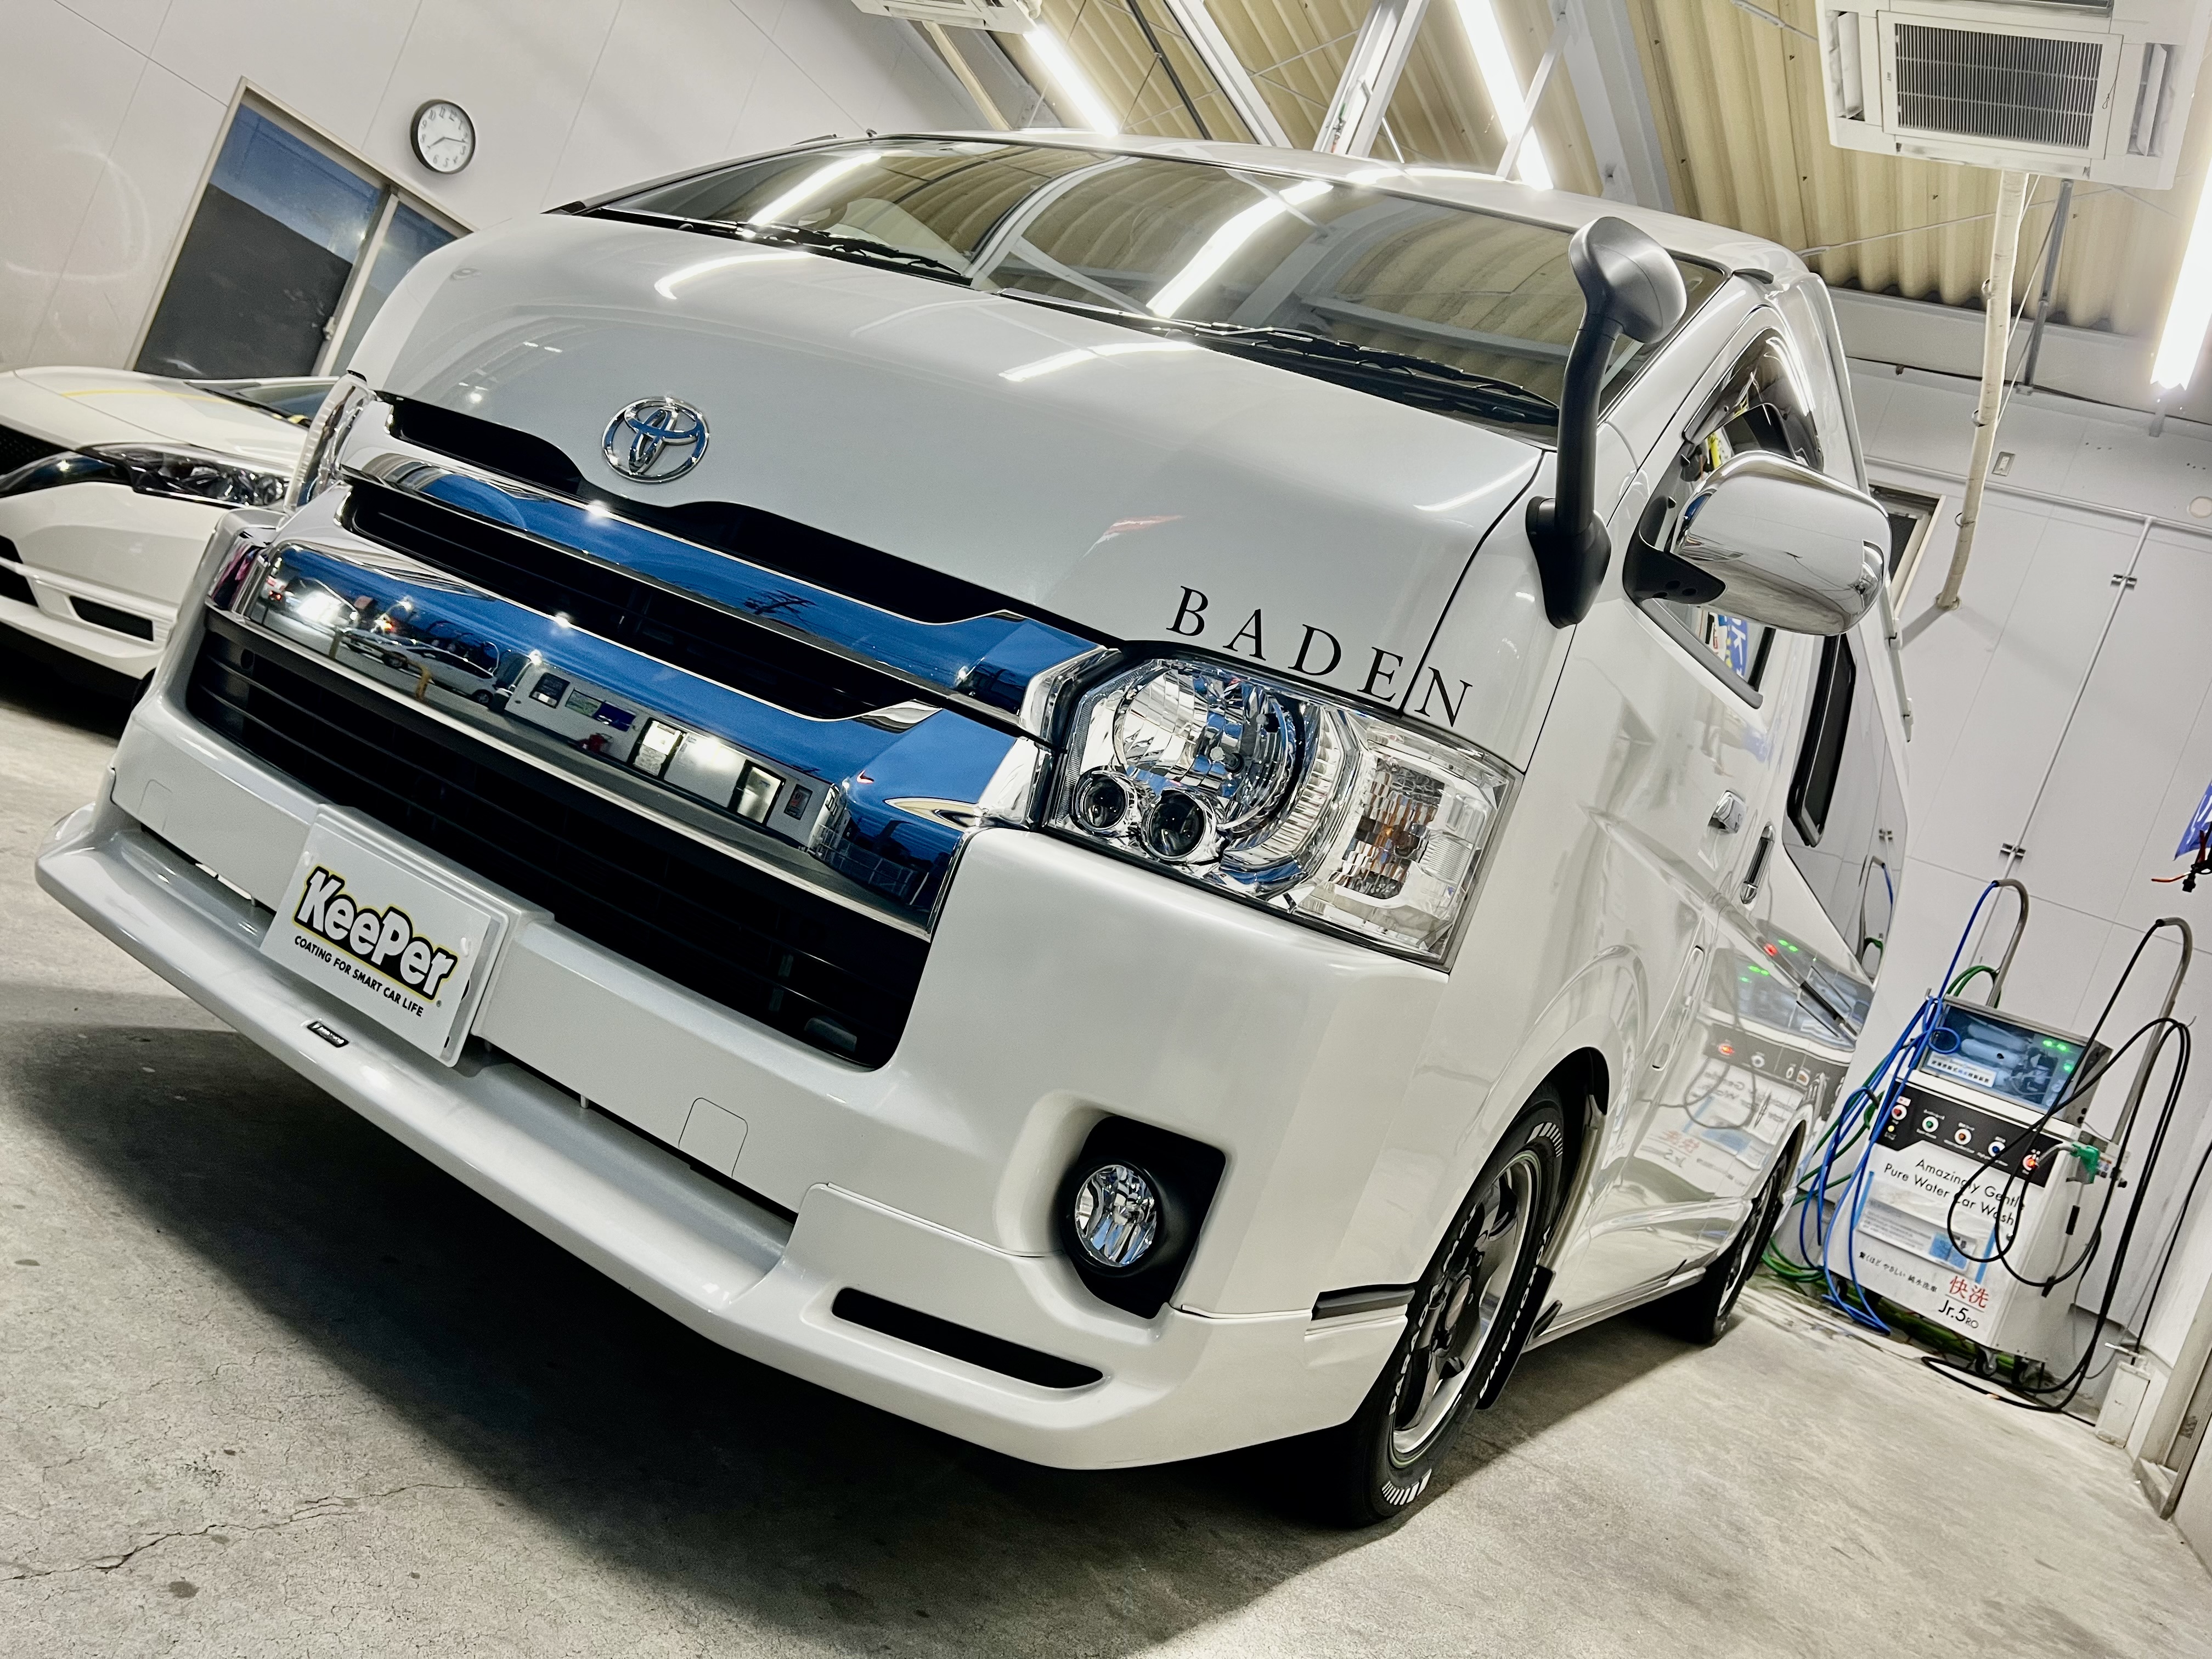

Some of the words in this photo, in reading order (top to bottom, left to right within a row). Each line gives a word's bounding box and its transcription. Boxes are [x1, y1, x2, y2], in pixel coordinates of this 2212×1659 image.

[1166, 585, 1472, 727] BADEN
[294, 865, 458, 1002] KeePer
[295, 935, 332, 963] COATING
[334, 957, 351, 975] FOR
[353, 968, 383, 992] SMART
[383, 987, 402, 1005] CAR
[402, 997, 424, 1018] LIFE
[1884, 1163, 1909, 1182] Pure
[1914, 1174, 1950, 1198] Water
[1954, 1193, 1977, 1209] ar
[1915, 1159, 1980, 1194] Amaziny
[1984, 1186, 2025, 1211] Gentl
[1480, 1226, 1550, 1399] YOKOHAMA
[1949, 1275, 1989, 1309] 快洗
[1389, 1283, 1440, 1415] PARADA
